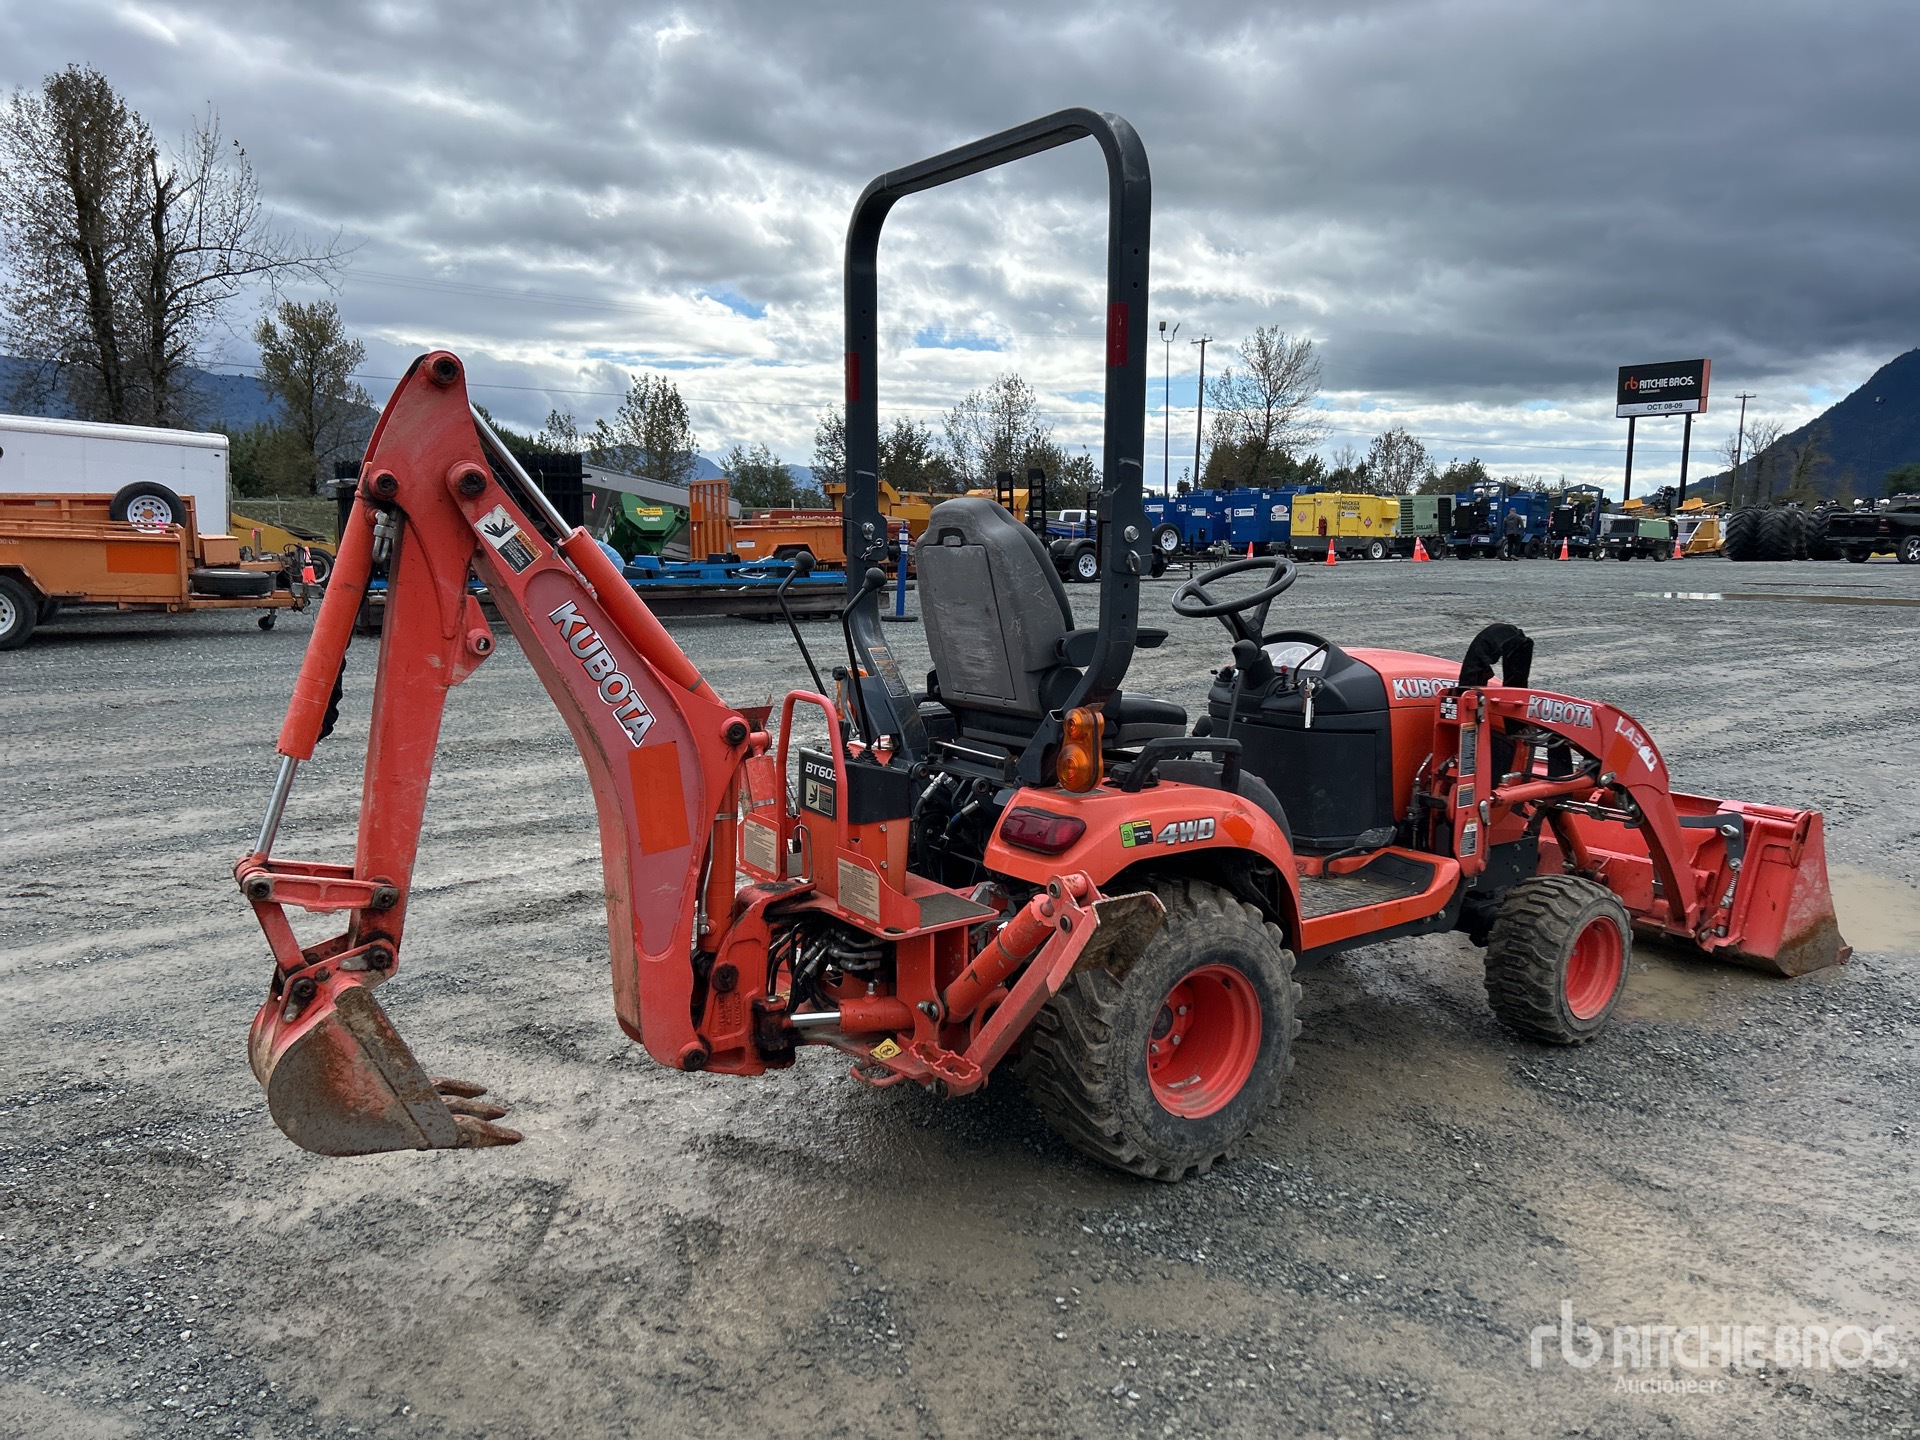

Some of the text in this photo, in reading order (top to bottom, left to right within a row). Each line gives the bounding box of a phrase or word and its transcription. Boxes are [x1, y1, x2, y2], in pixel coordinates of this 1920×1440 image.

[1639, 378, 1668, 388] RITCHIE
[1669, 376, 1695, 386] BROS.
[548, 600, 656, 747] KUBOTA
[1392, 677, 1459, 700] KUBOT
[1527, 695, 1593, 729] KUBOTA
[1156, 817, 1216, 846] 4WD
